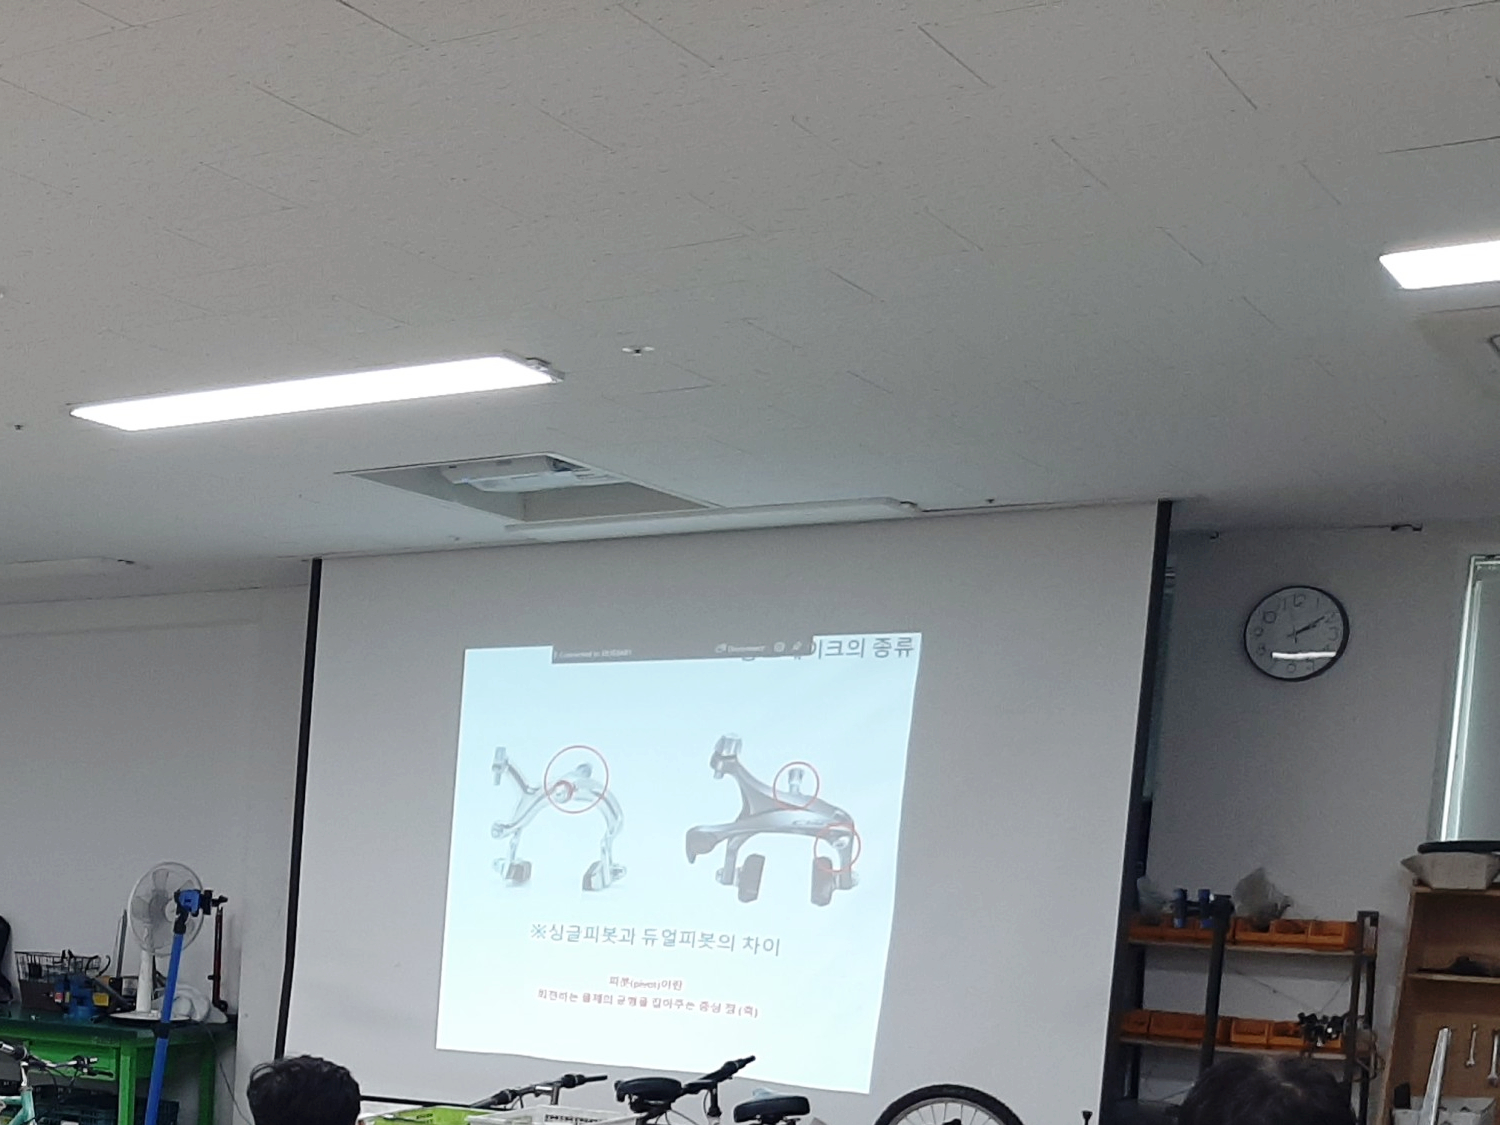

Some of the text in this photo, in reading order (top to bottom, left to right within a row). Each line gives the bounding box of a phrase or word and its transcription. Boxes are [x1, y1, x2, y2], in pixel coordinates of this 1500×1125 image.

[872, 636, 915, 659] 종류
[641, 927, 736, 952] 듀얼피봇의
[741, 935, 781, 957] 차이
